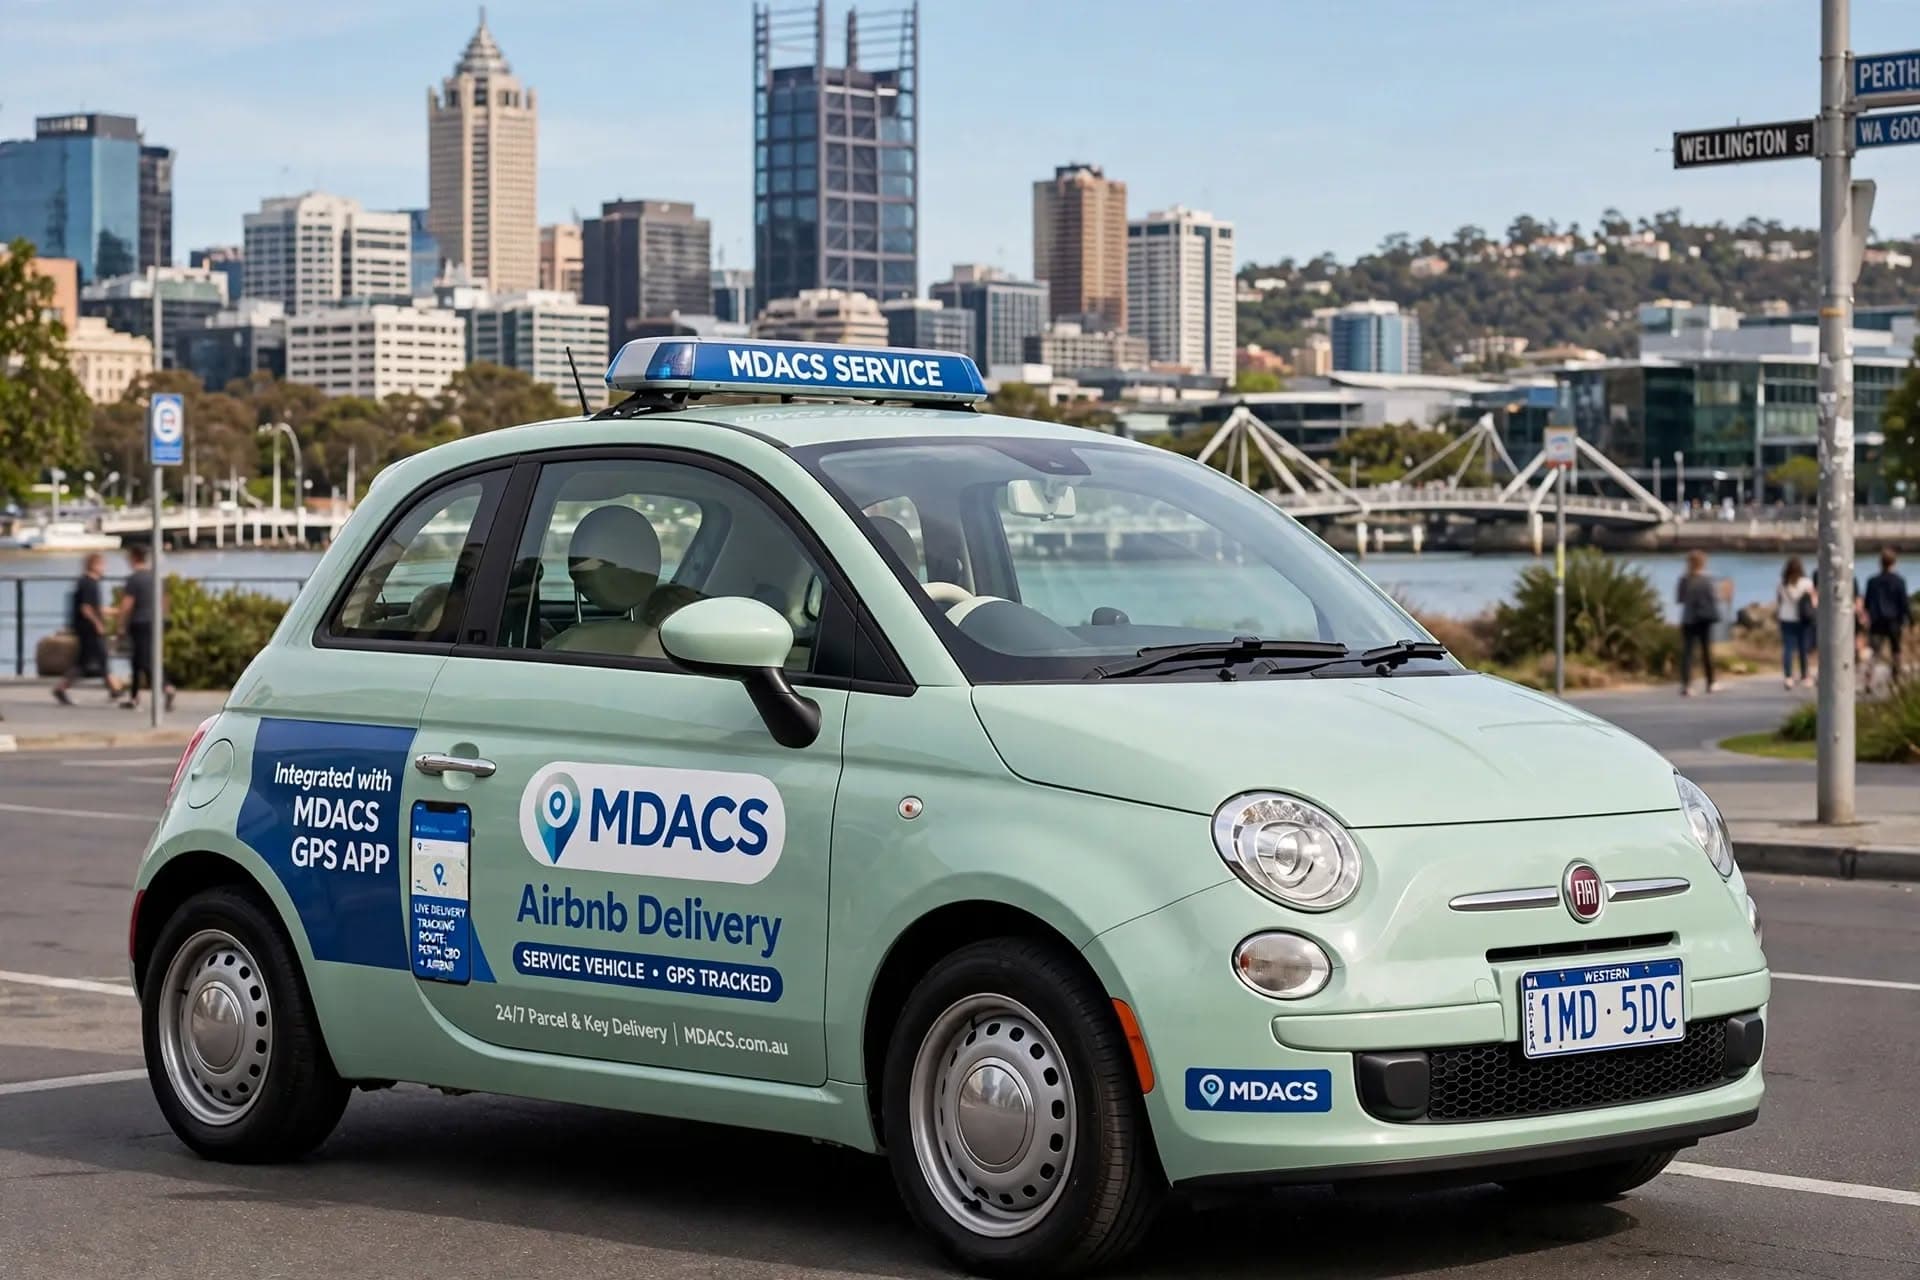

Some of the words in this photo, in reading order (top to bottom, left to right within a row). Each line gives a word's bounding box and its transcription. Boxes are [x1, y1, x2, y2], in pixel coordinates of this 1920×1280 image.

[1860, 58, 1920, 88] PERTH
[1680, 129, 1787, 162] WELLINGTON
[1795, 134, 1811, 151] ST
[1860, 120, 1884, 143] WA
[727, 349, 828, 380] MDACS
[832, 355, 943, 387] SERVICE
[274, 762, 355, 791] Integrated
[357, 768, 392, 792] with
[293, 795, 380, 833] MDACS
[589, 788, 769, 856] MDACS
[291, 836, 338, 870] GPS
[342, 841, 390, 874] APP
[1574, 879, 1598, 906] FIAT
[516, 883, 628, 933] Airbnb
[638, 894, 782, 959] Delivery
[522, 949, 581, 973] SERVICE
[584, 956, 645, 980] VEHICLE
[666, 965, 696, 986] GPS
[699, 969, 772, 994] TRACKED
[1583, 967, 1630, 983] WESTERN
[495, 1004, 525, 1023] 24/7
[528, 1007, 569, 1029] Parcel
[571, 1013, 581, 1030] &
[584, 1014, 609, 1037] Key
[612, 1017, 668, 1045] Delivery
[684, 1026, 789, 1056] MDACS.com.au
[1229, 1081, 1318, 1101] MDACS
